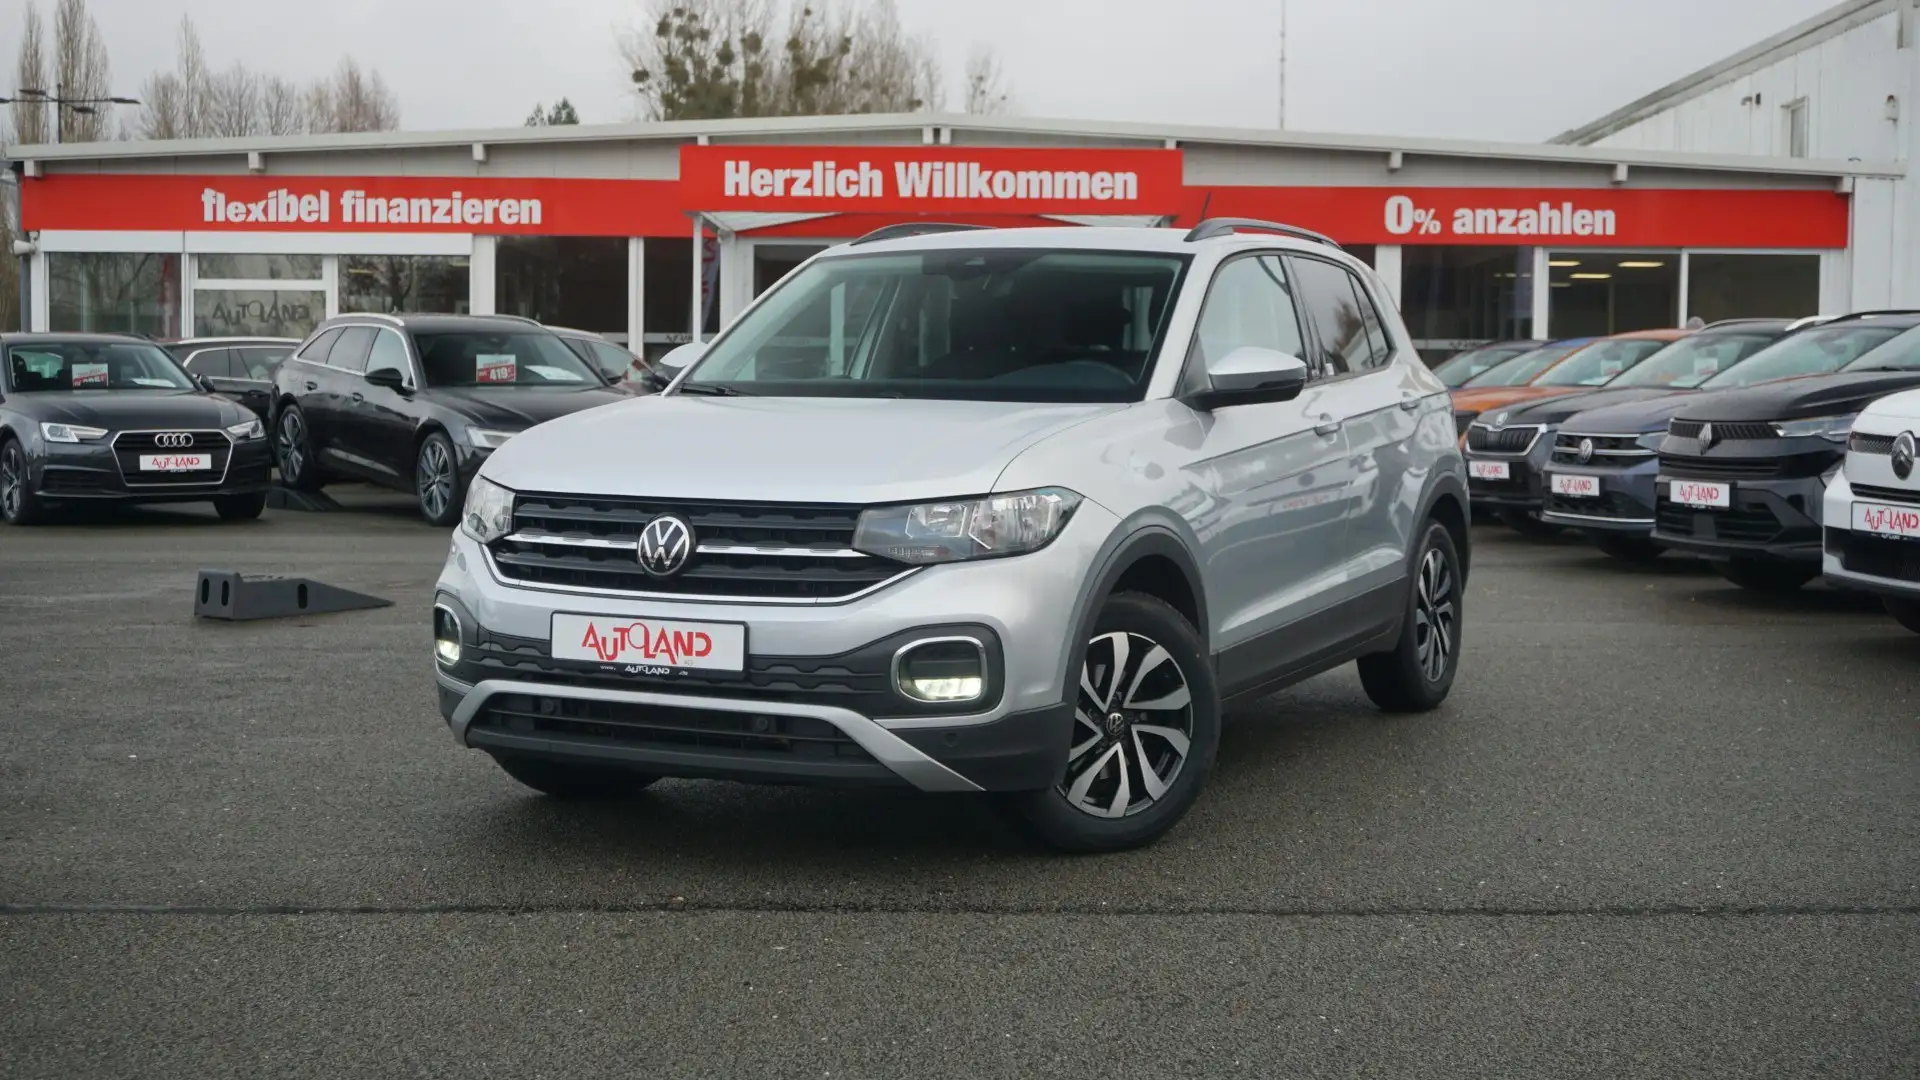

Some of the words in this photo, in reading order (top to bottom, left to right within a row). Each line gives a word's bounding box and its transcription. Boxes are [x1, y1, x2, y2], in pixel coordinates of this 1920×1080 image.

[724, 160, 883, 198] Herzlich
[894, 161, 1138, 200] Willkommen
[201, 188, 330, 223] flexibel
[340, 190, 542, 225] finanzieren
[1384, 195, 1442, 235] 0%
[1452, 201, 1616, 236] anzahlen
[1864, 507, 1919, 533] AUTOLAND
[581, 622, 713, 665] AUTOLAND
